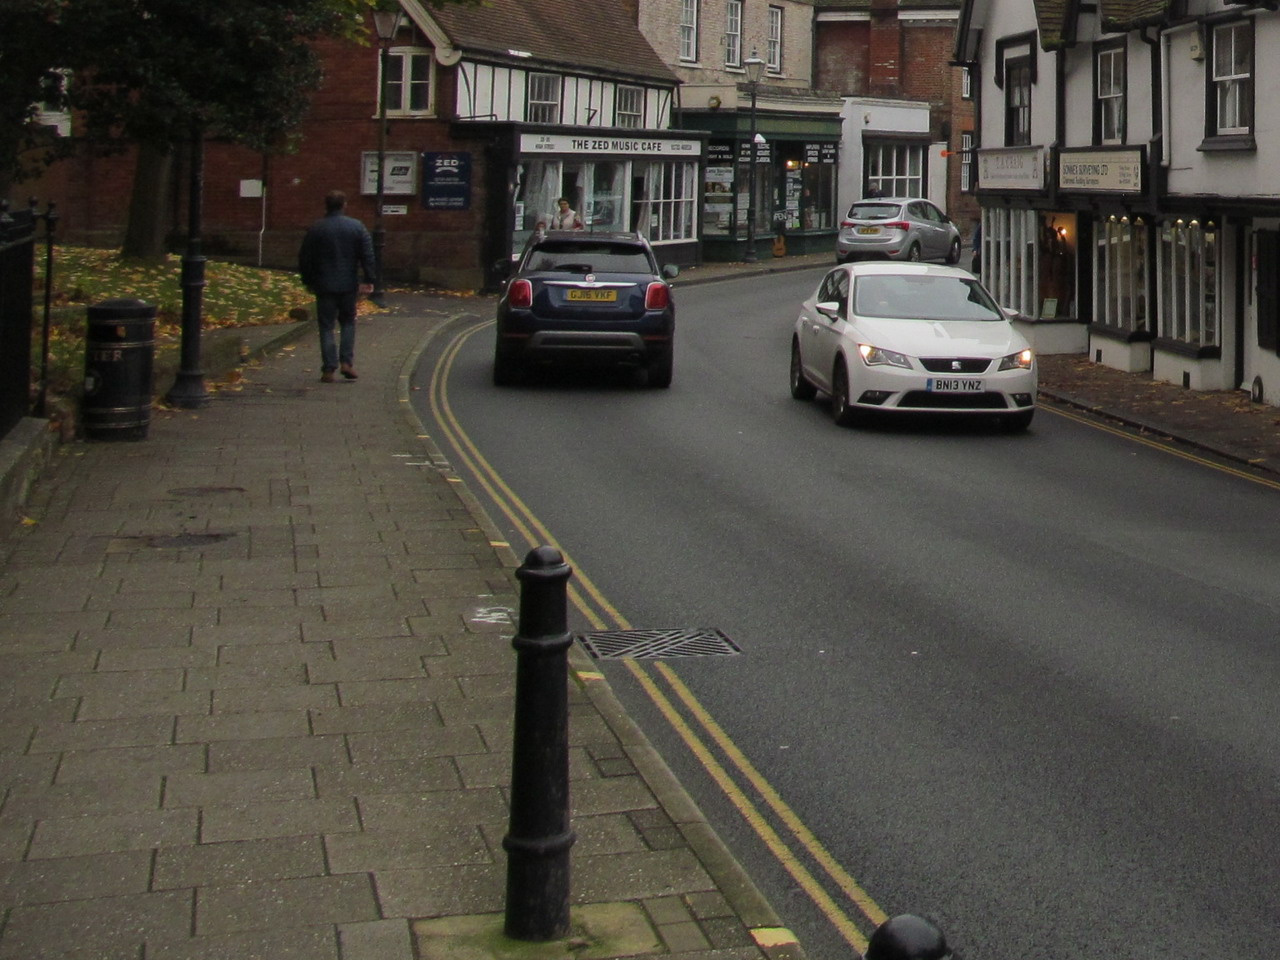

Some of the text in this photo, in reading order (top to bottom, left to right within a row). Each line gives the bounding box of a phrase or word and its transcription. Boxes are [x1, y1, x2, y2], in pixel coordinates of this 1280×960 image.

[572, 140, 589, 150] THE
[592, 140, 609, 150] ZED
[611, 141, 638, 151] MUSIC
[641, 142, 662, 152] CAFE
[935, 380, 982, 390] BN13 YNZ
